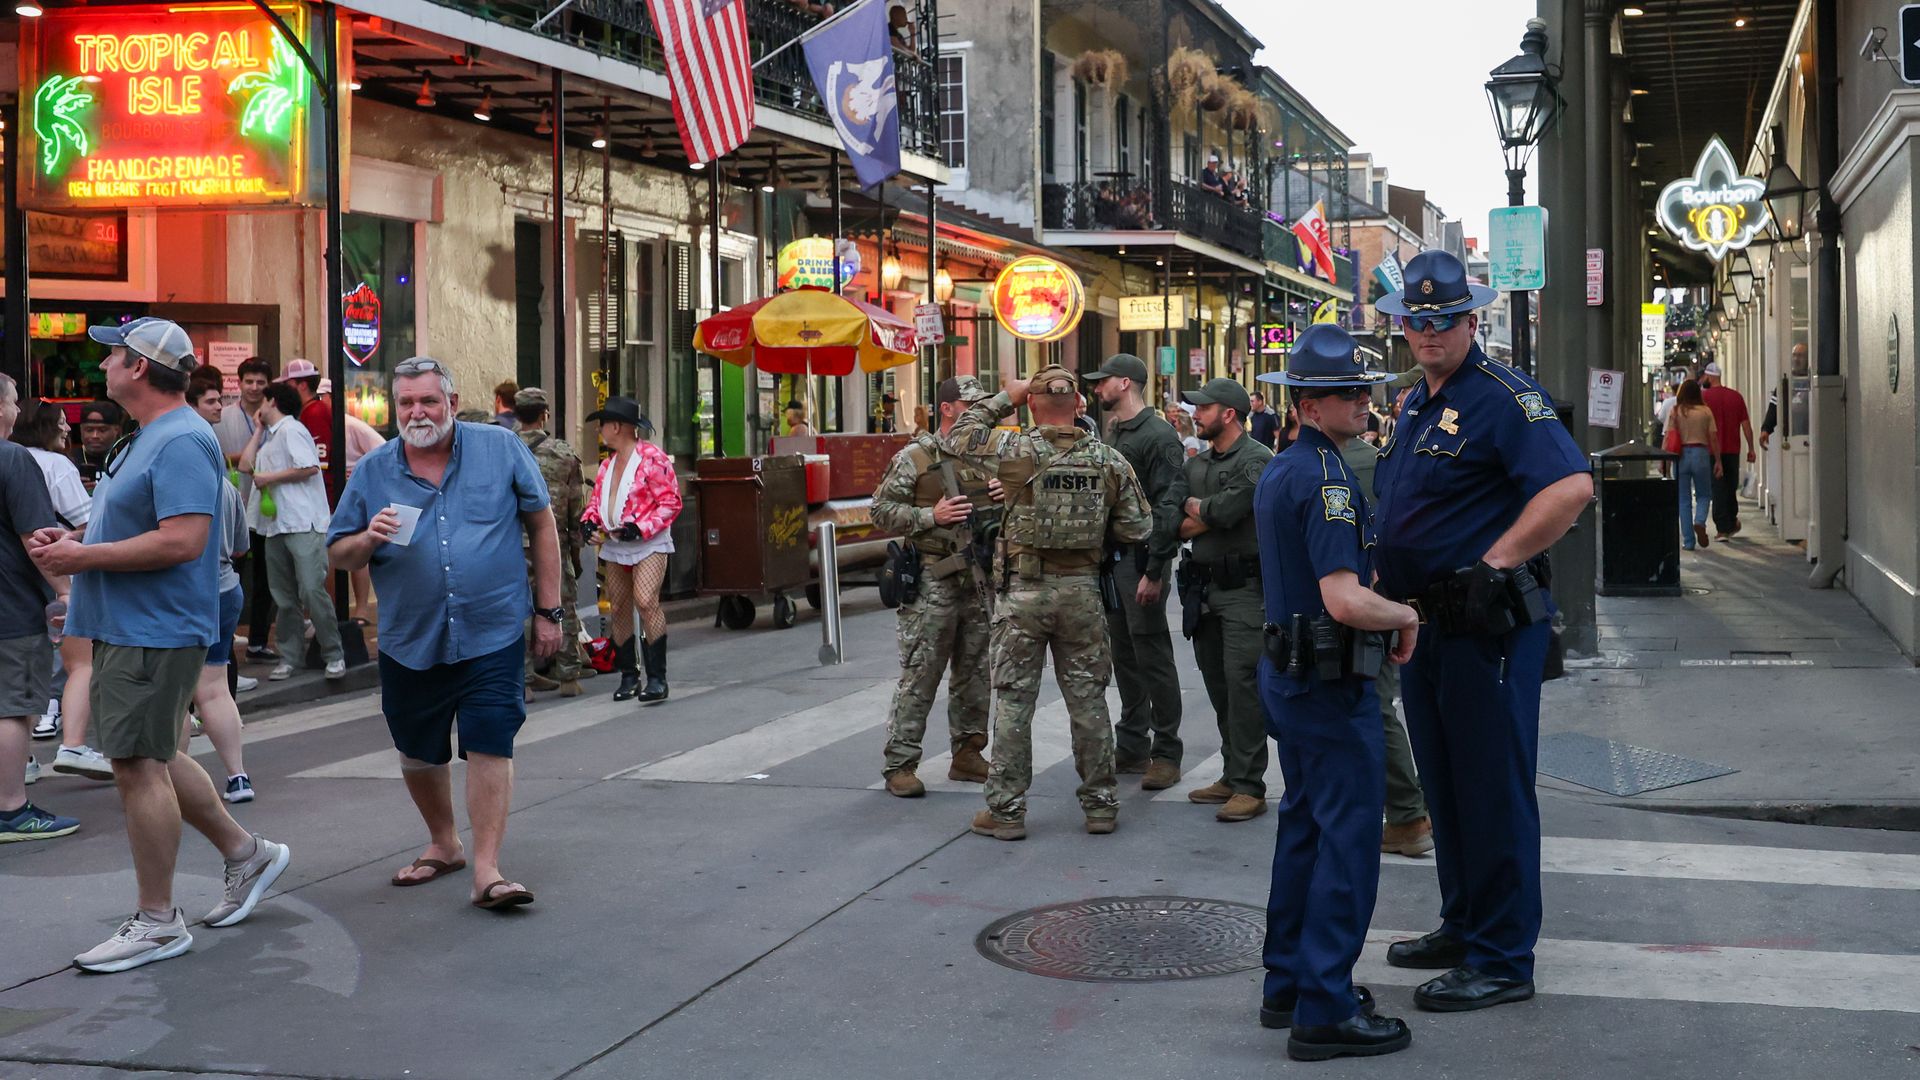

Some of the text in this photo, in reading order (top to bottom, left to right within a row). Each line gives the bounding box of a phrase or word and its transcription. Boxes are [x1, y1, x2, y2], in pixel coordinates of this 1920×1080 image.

[75, 30, 259, 73] TROPICAL
[128, 75, 203, 115] ISLE
[102, 120, 176, 139] BOURBON
[1681, 184, 1757, 204] Bourbon
[1008, 273, 1064, 298] Honky
[921, 326, 937, 334] LANE
[1642, 318, 1663, 326] PEED
[1646, 334, 1657, 348] 5
[753, 459, 762, 471] 2
[1042, 474, 1101, 490] MSRT
